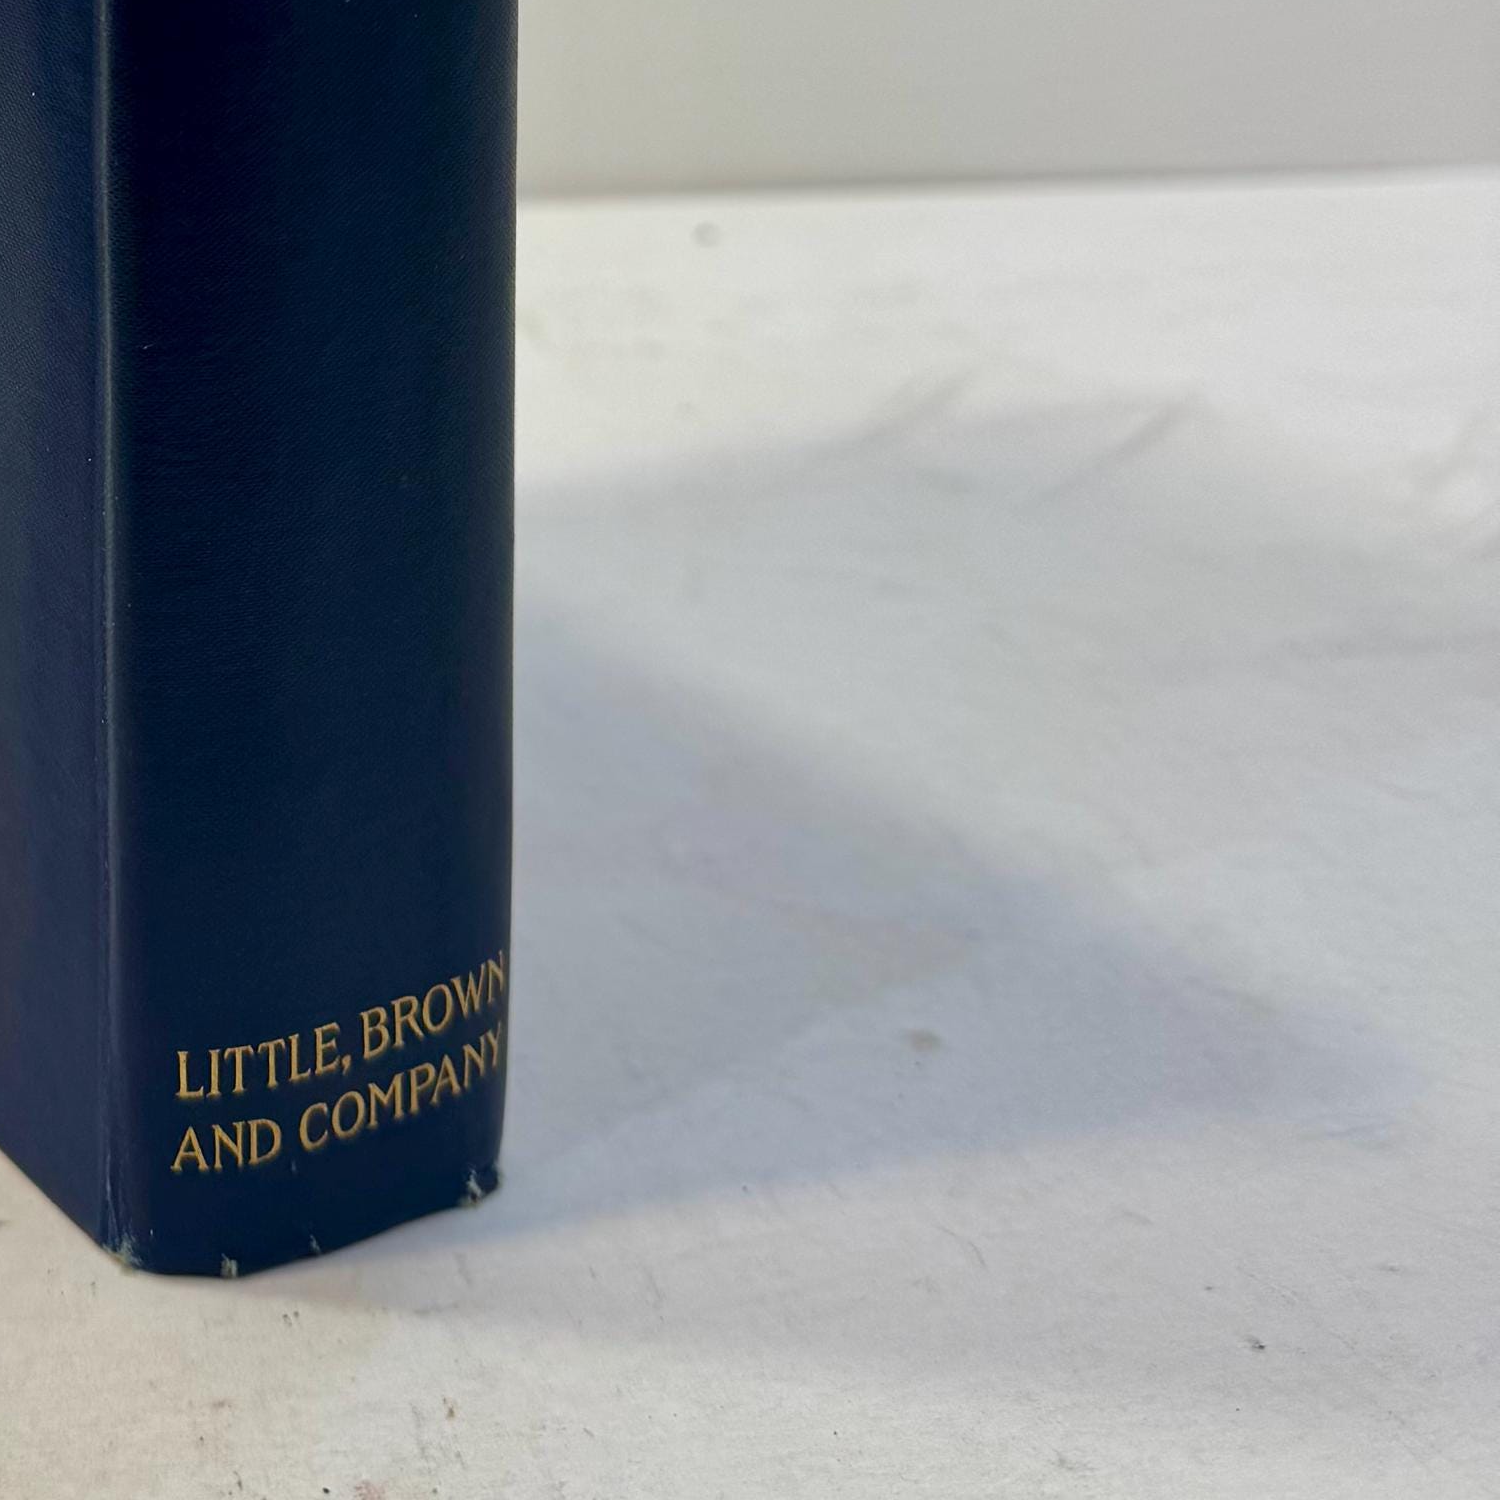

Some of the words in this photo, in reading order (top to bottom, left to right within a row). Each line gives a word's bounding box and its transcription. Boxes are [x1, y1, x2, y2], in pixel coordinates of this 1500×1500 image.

[170, 1118, 283, 1173] AND
[299, 1021, 503, 1152] COMPANY
[175, 1022, 352, 1099] LITTLE,
[360, 950, 506, 1060] BROWN
